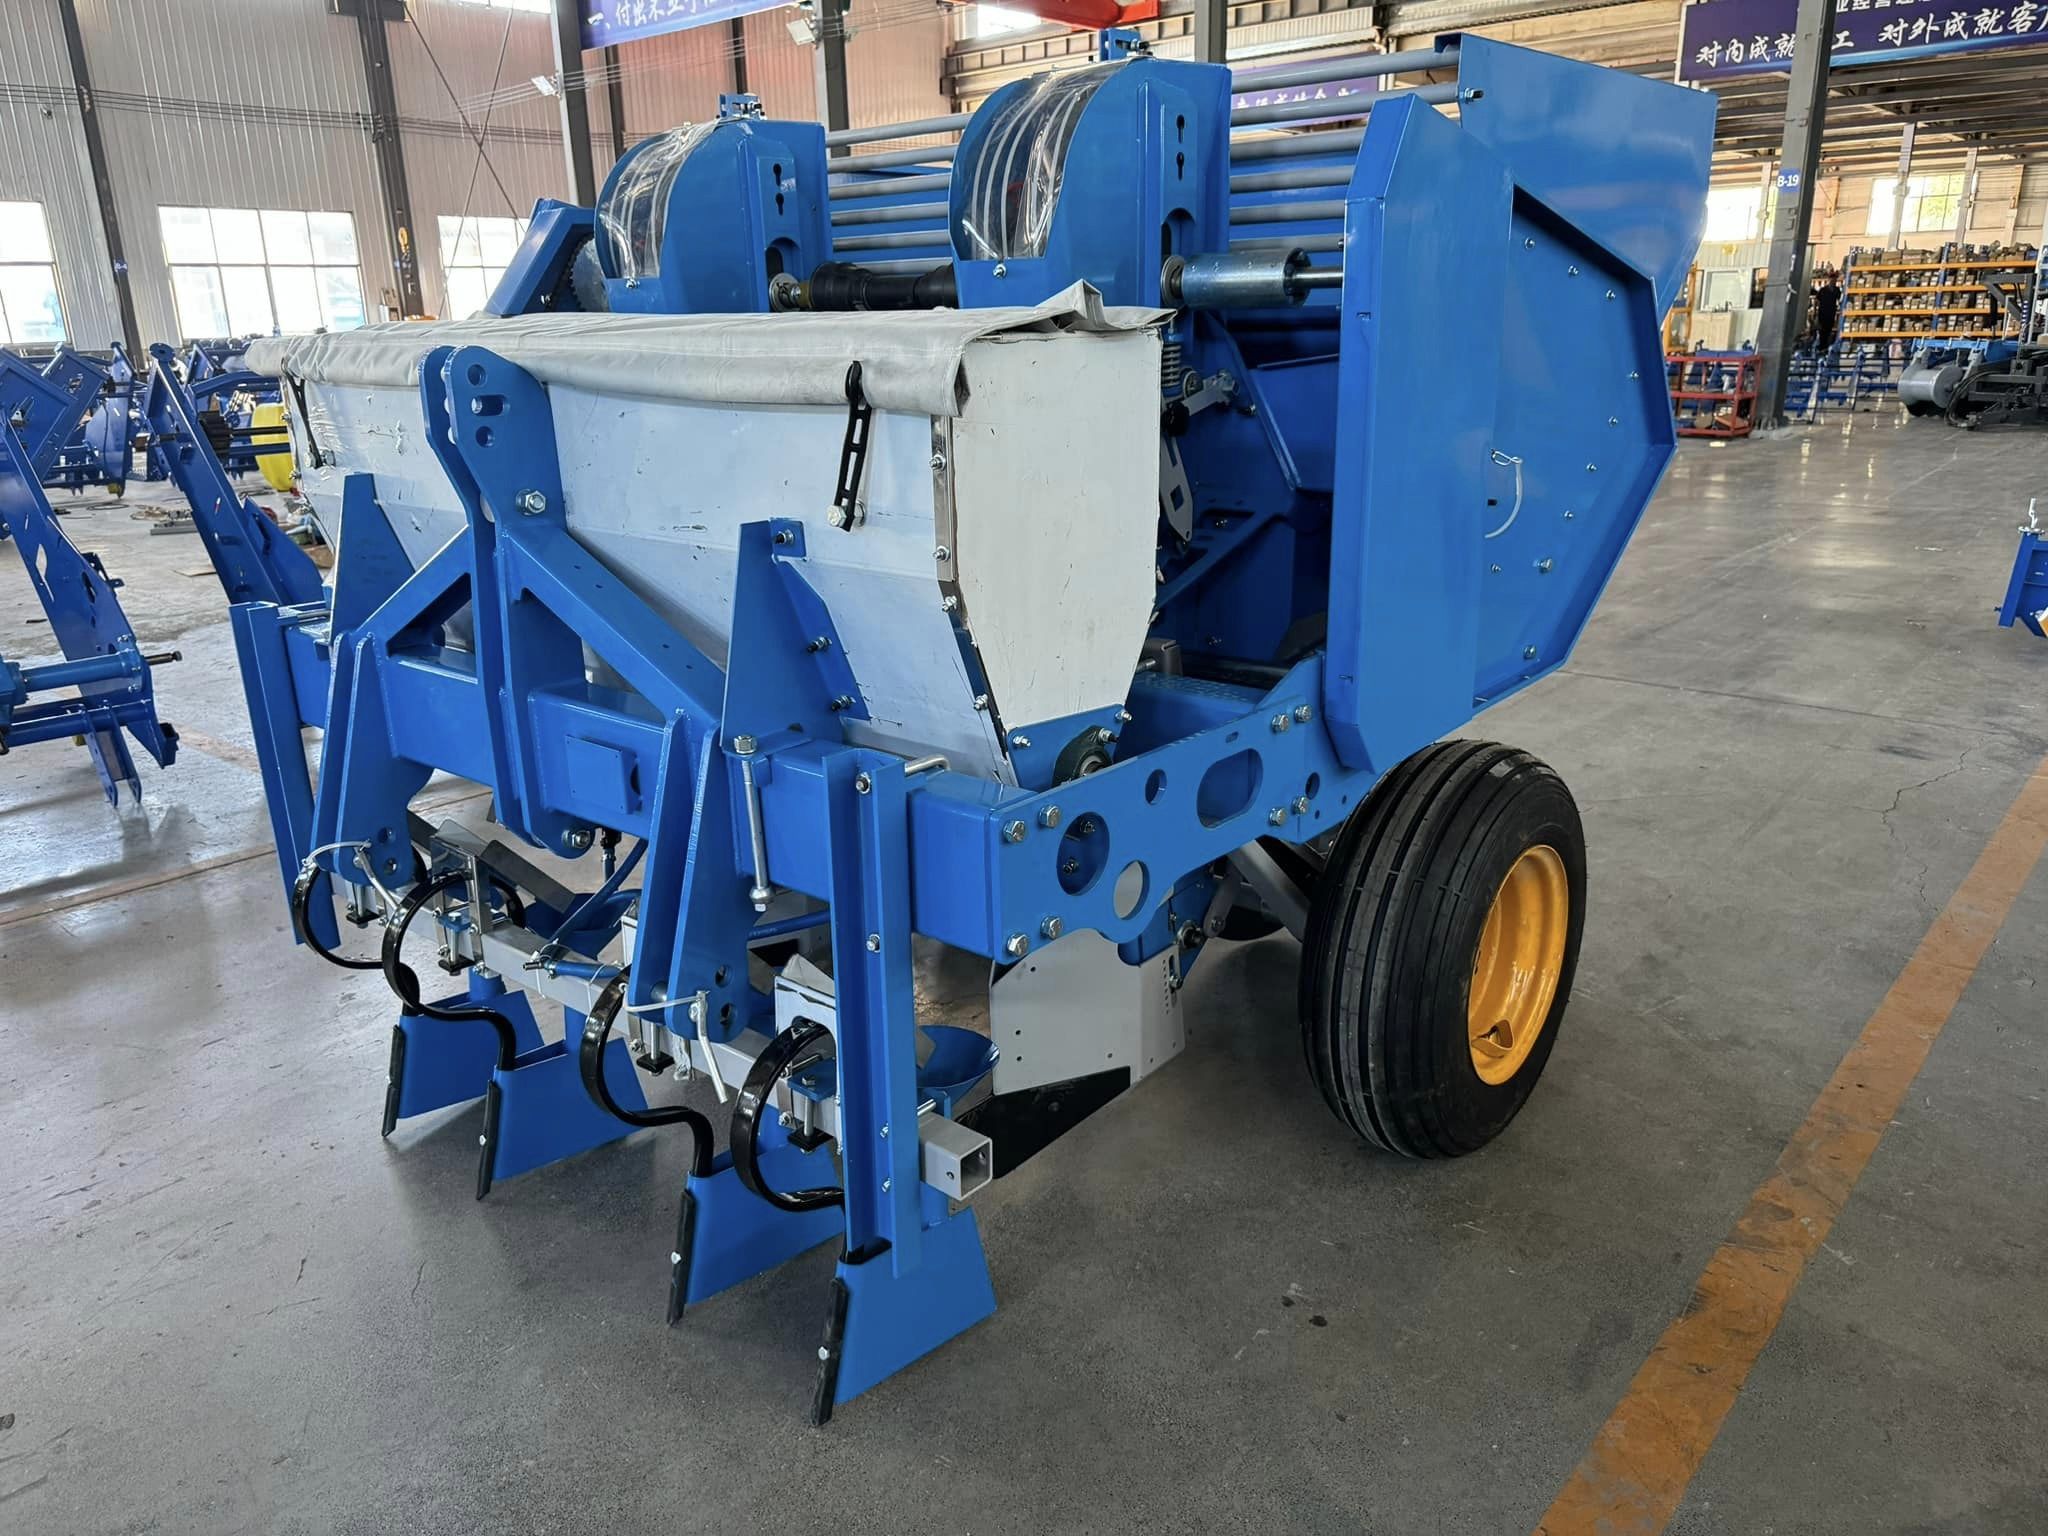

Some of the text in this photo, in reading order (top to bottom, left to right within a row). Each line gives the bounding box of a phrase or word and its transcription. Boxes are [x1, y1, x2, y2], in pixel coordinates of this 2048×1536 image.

[1696, 30, 1854, 68] 对内成就工
[1777, 174, 1799, 187] B-19
